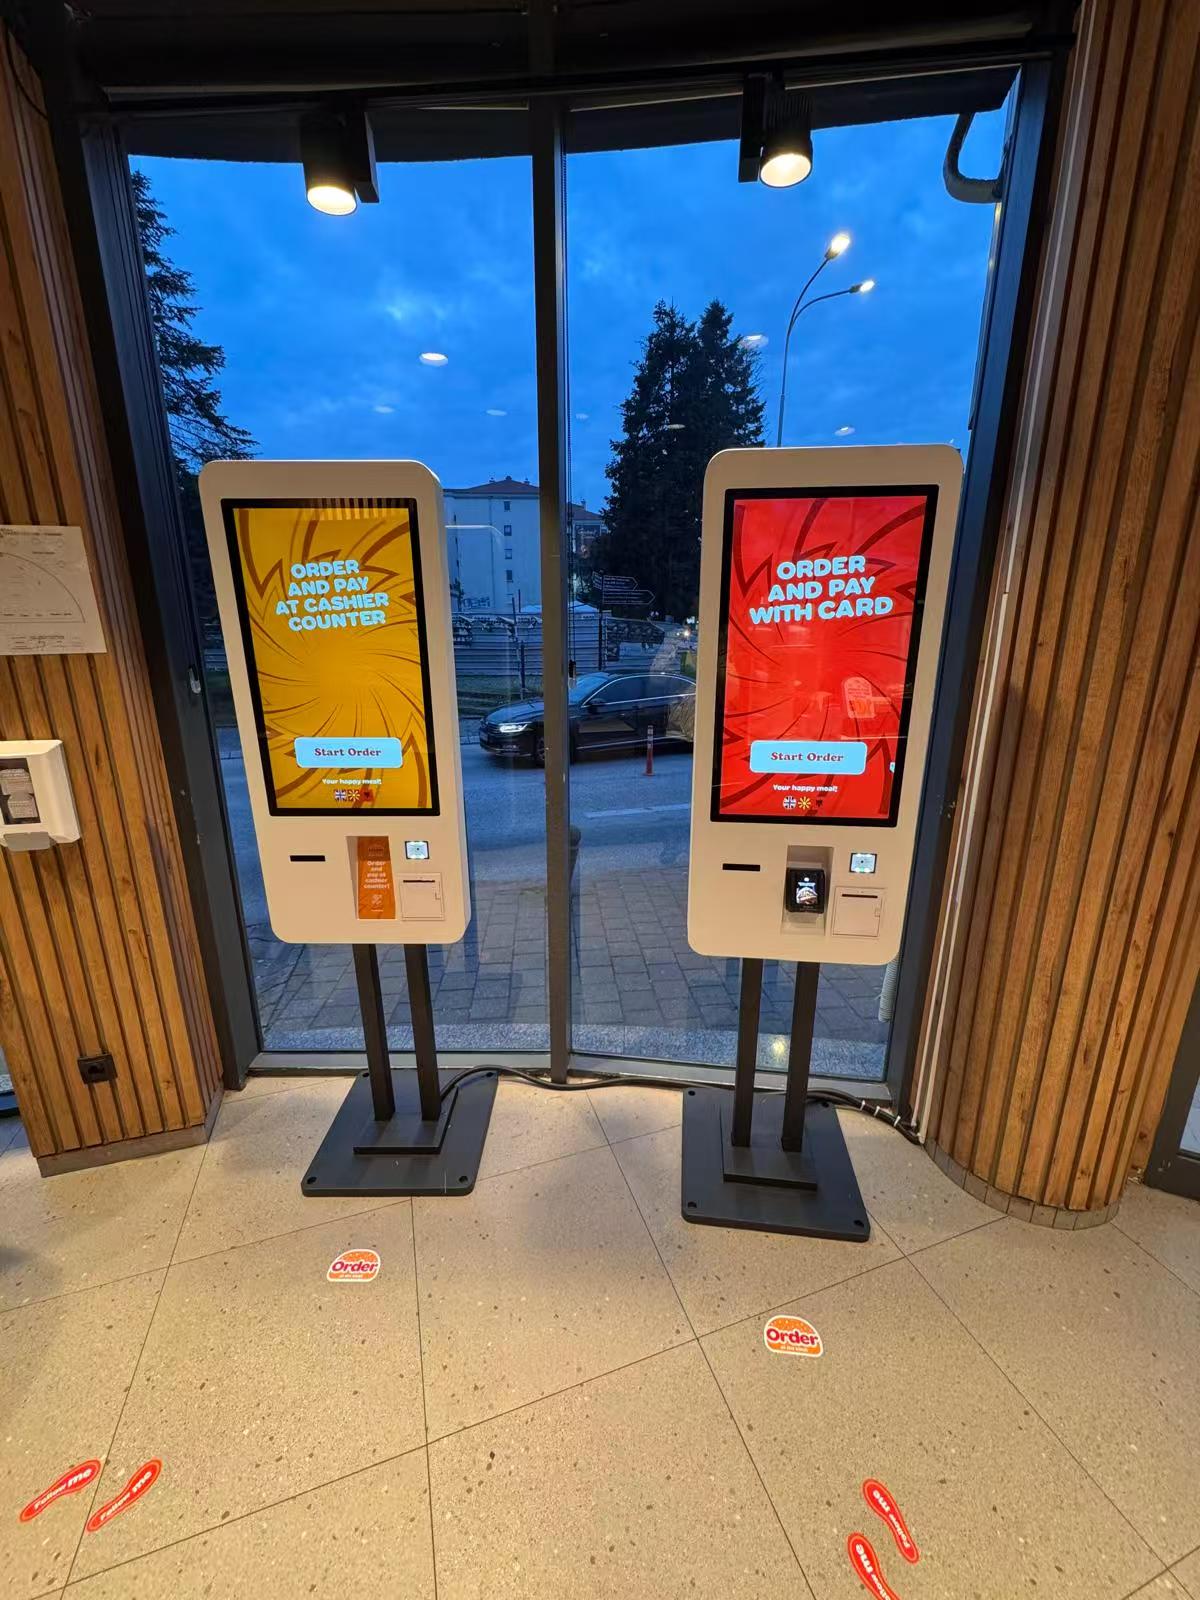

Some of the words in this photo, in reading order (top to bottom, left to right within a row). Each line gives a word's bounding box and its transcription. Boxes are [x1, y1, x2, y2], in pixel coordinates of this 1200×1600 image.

[290, 559, 360, 579] ORDER
[776, 555, 866, 580] ORDER
[288, 580, 330, 597] AND
[333, 576, 369, 593] PAY
[767, 581, 823, 602] AND
[828, 576, 876, 597] PAY
[275, 599, 299, 615] AT
[303, 592, 390, 613] CASHIER
[749, 602, 813, 625] WITH
[817, 596, 894, 620] CARD
[288, 609, 386, 632] COUNTER
[314, 747, 345, 757] Start
[347, 747, 382, 757] Order
[770, 751, 804, 761] Start
[806, 752, 845, 762] Order
[339, 778, 361, 786] happy
[791, 784, 816, 793] happy
[331, 1260, 379, 1272] Order
[766, 1328, 819, 1346] Order
[33, 1483, 67, 1510] Follow
[67, 1468, 92, 1488] me
[100, 1492, 131, 1521] Follow
[131, 1471, 153, 1493] me
[872, 1489, 890, 1512] me
[888, 1513, 911, 1548] Follow
[855, 1543, 873, 1573] me
[871, 1574, 891, 1600] ollow
